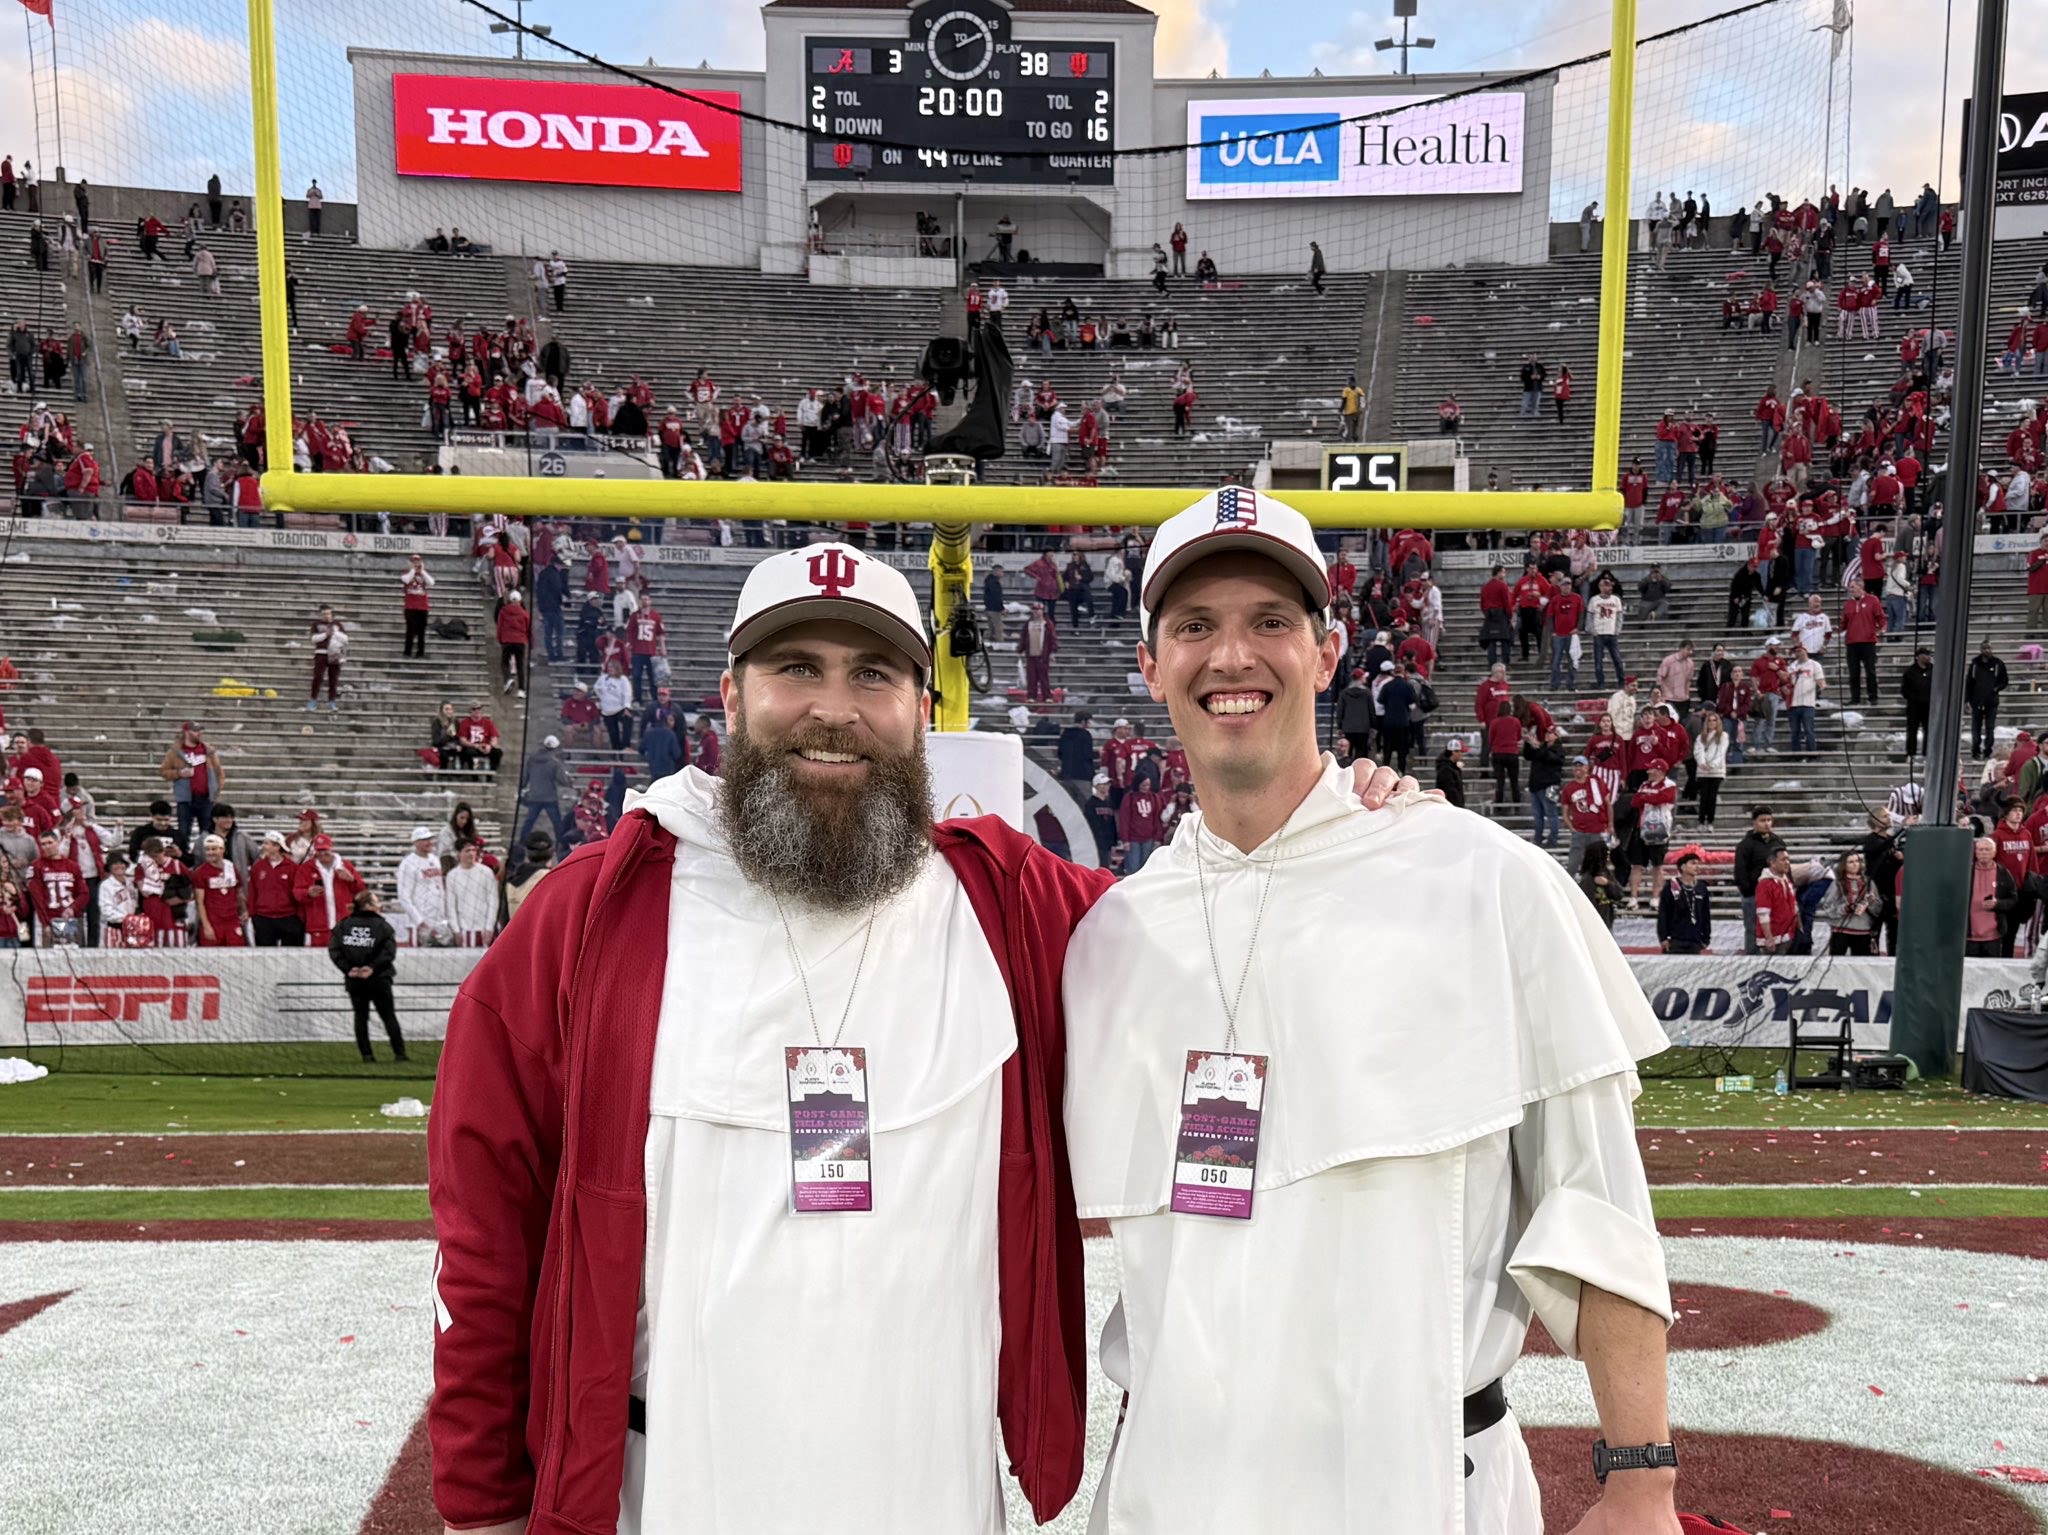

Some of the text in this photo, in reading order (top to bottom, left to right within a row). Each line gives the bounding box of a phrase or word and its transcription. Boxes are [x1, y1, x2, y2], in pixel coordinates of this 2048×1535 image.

[987, 20, 999, 30] 15
[904, 41, 925, 52] MIN
[995, 44, 1022, 54] PLAY
[888, 49, 902, 73] 3
[1020, 52, 1048, 76] 38
[924, 69, 932, 79] 5
[987, 69, 1000, 80] 10
[812, 86, 826, 109] 2
[834, 90, 862, 107] TOL
[919, 87, 1003, 116] 20:00
[1046, 94, 1073, 110] TOL
[1094, 90, 1109, 114] 2
[812, 114, 826, 134] 4
[834, 118, 882, 135] DOWN
[1026, 121, 1072, 139] TO GO
[1087, 118, 1109, 141] 16
[426, 107, 710, 158] HONDA
[1218, 129, 1323, 168] UCLA
[1353, 123, 1511, 167] Health
[882, 149, 902, 165] ON
[918, 149, 947, 169] 44
[952, 153, 1003, 167] YD LINE
[1049, 154, 1112, 169] QUARTER
[539, 457, 565, 475] 26
[1331, 455, 1396, 492] 25
[270, 532, 328, 547] TRADITION
[373, 536, 411, 549] HONOR
[658, 547, 711, 561] STRENGTH
[908, 554, 929, 567] ROS
[1488, 552, 1525, 566] PASSIO
[1596, 550, 1630, 563] ENGTH
[47, 881, 75, 909] 15
[342, 935, 376, 947] SECURITY
[26, 975, 220, 1022] ESPN
[820, 1164, 844, 1178] 150
[1200, 1168, 1228, 1184] 050
